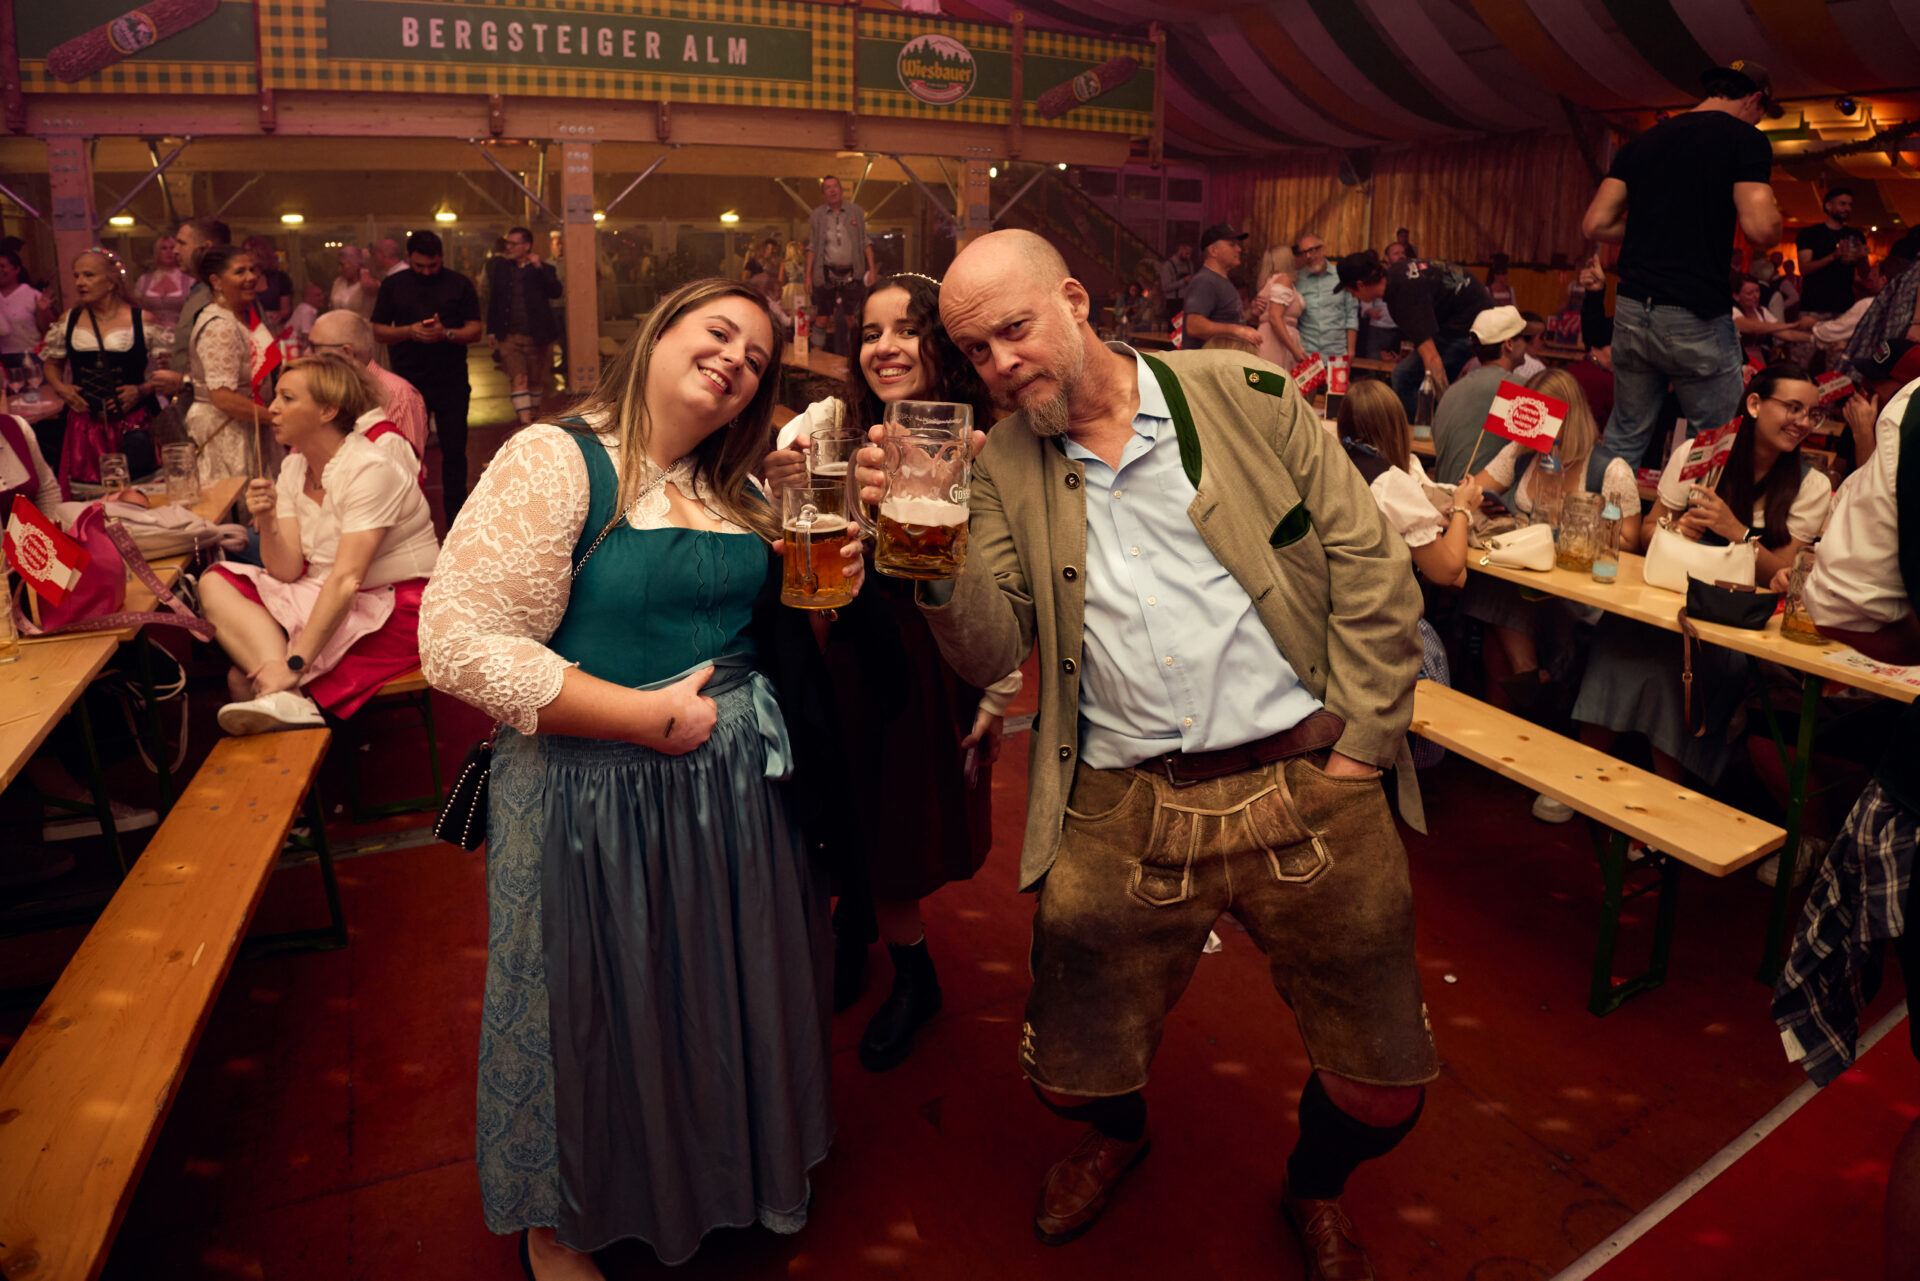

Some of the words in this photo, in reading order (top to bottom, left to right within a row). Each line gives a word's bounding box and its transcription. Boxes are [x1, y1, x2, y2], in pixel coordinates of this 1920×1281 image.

[402, 16, 661, 60] BERGSTEIGER
[683, 34, 747, 65] ALM
[902, 59, 972, 83] Wiesbauer
